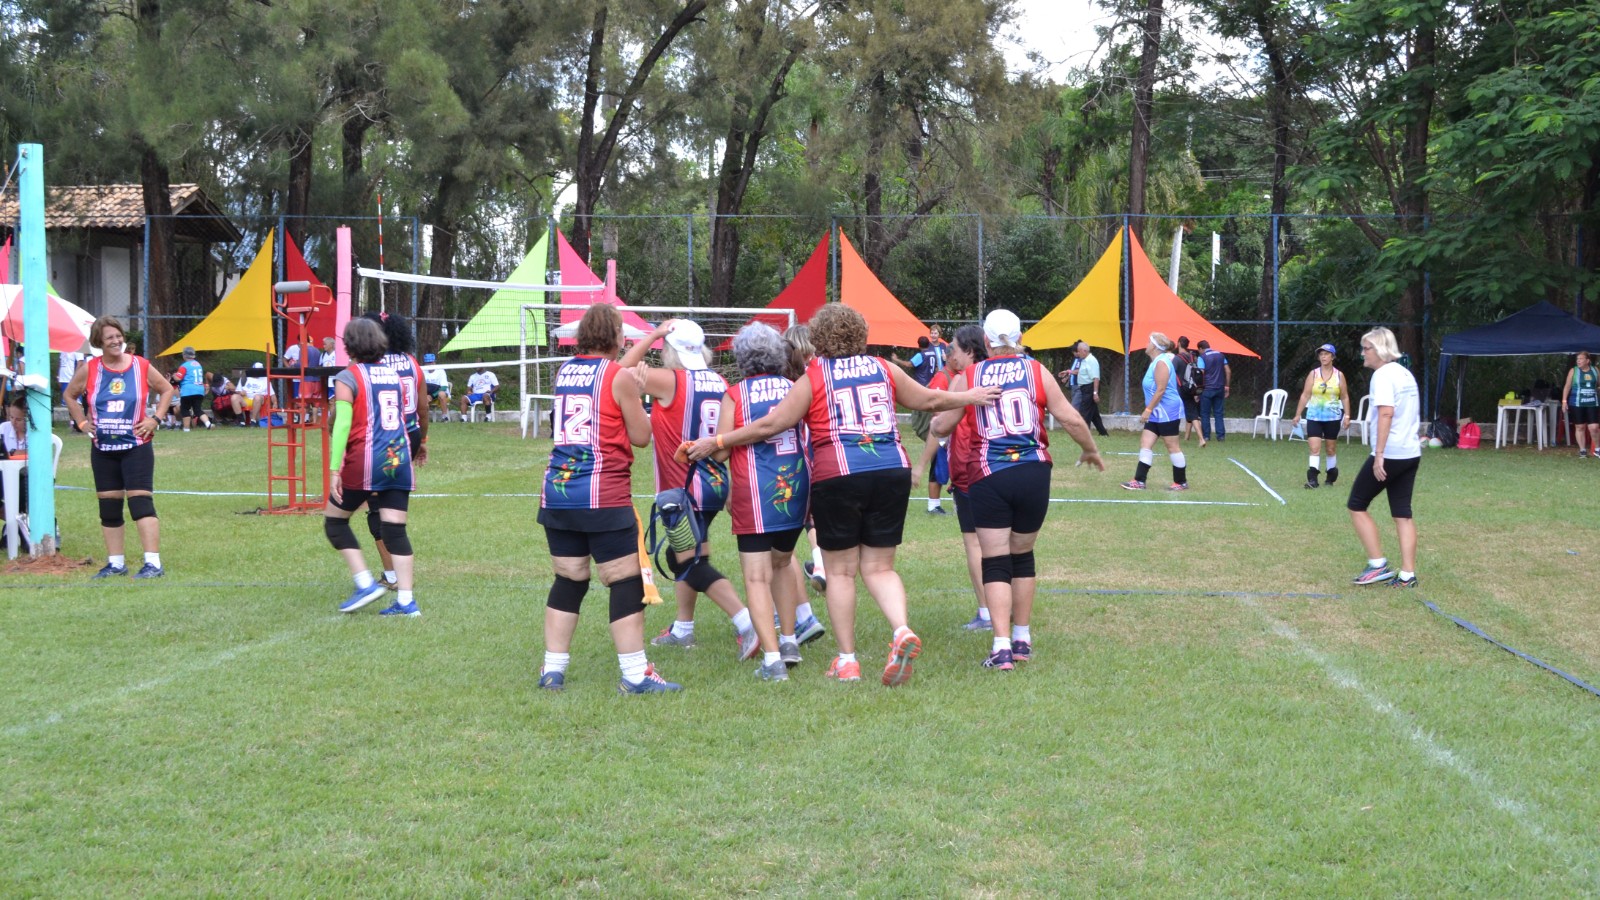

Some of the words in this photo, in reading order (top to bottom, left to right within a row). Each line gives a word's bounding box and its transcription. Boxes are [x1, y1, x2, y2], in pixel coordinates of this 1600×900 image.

[560, 364, 597, 374] ATIBA
[834, 354, 872, 369] ATIBA
[929, 356, 936, 374] 9
[985, 361, 1022, 375] ATIBA
[833, 363, 878, 380] BAURU
[981, 369, 1026, 386] BAURU
[556, 374, 596, 388] BAURU
[750, 377, 790, 393] ATIBA
[106, 400, 125, 413] 20
[378, 390, 400, 431] 6
[832, 382, 893, 434] 15
[984, 388, 1034, 440] 10
[553, 394, 593, 445] 12
[698, 399, 722, 438] 8
